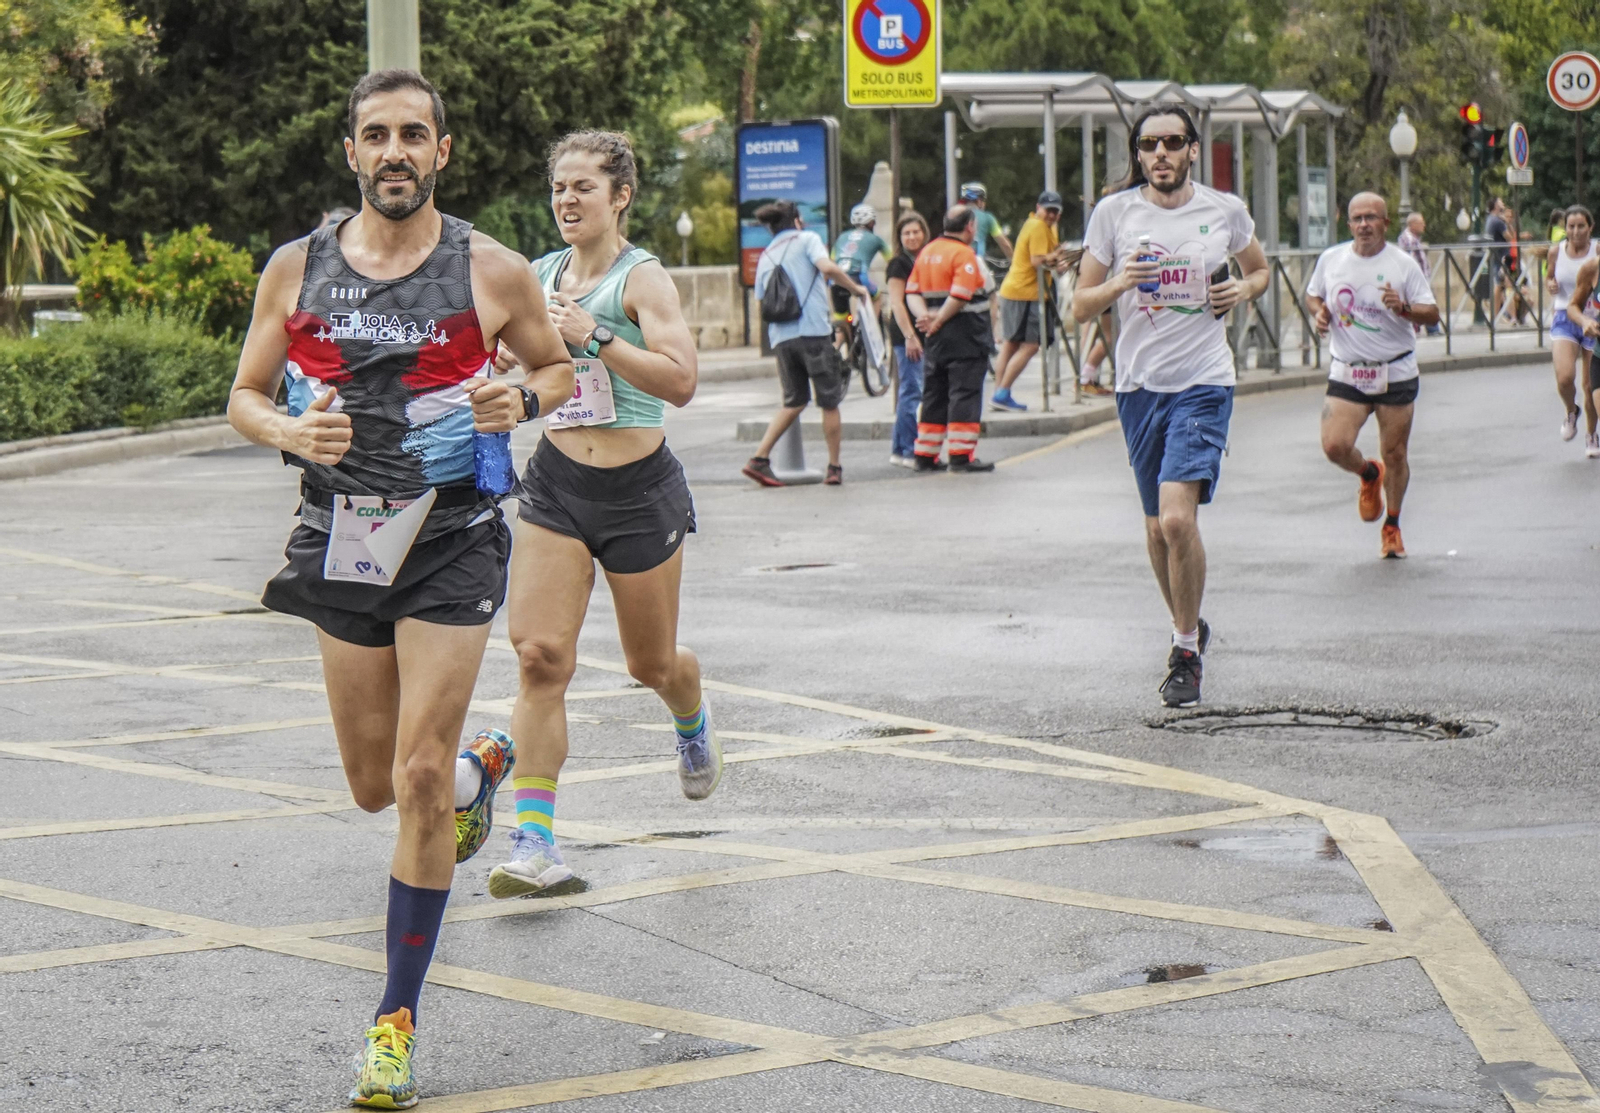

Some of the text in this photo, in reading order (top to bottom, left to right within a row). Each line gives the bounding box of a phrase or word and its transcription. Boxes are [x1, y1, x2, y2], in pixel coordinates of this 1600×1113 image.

[886, 20, 896, 34] P
[877, 38, 905, 49] BUS
[861, 72, 923, 85] SOLO BUS
[1561, 72, 1590, 90] 30
[852, 88, 933, 99] METROPOLITANO
[331, 287, 368, 299] GOBIK
[1163, 292, 1190, 300] vithas
[564, 410, 593, 420] vithas
